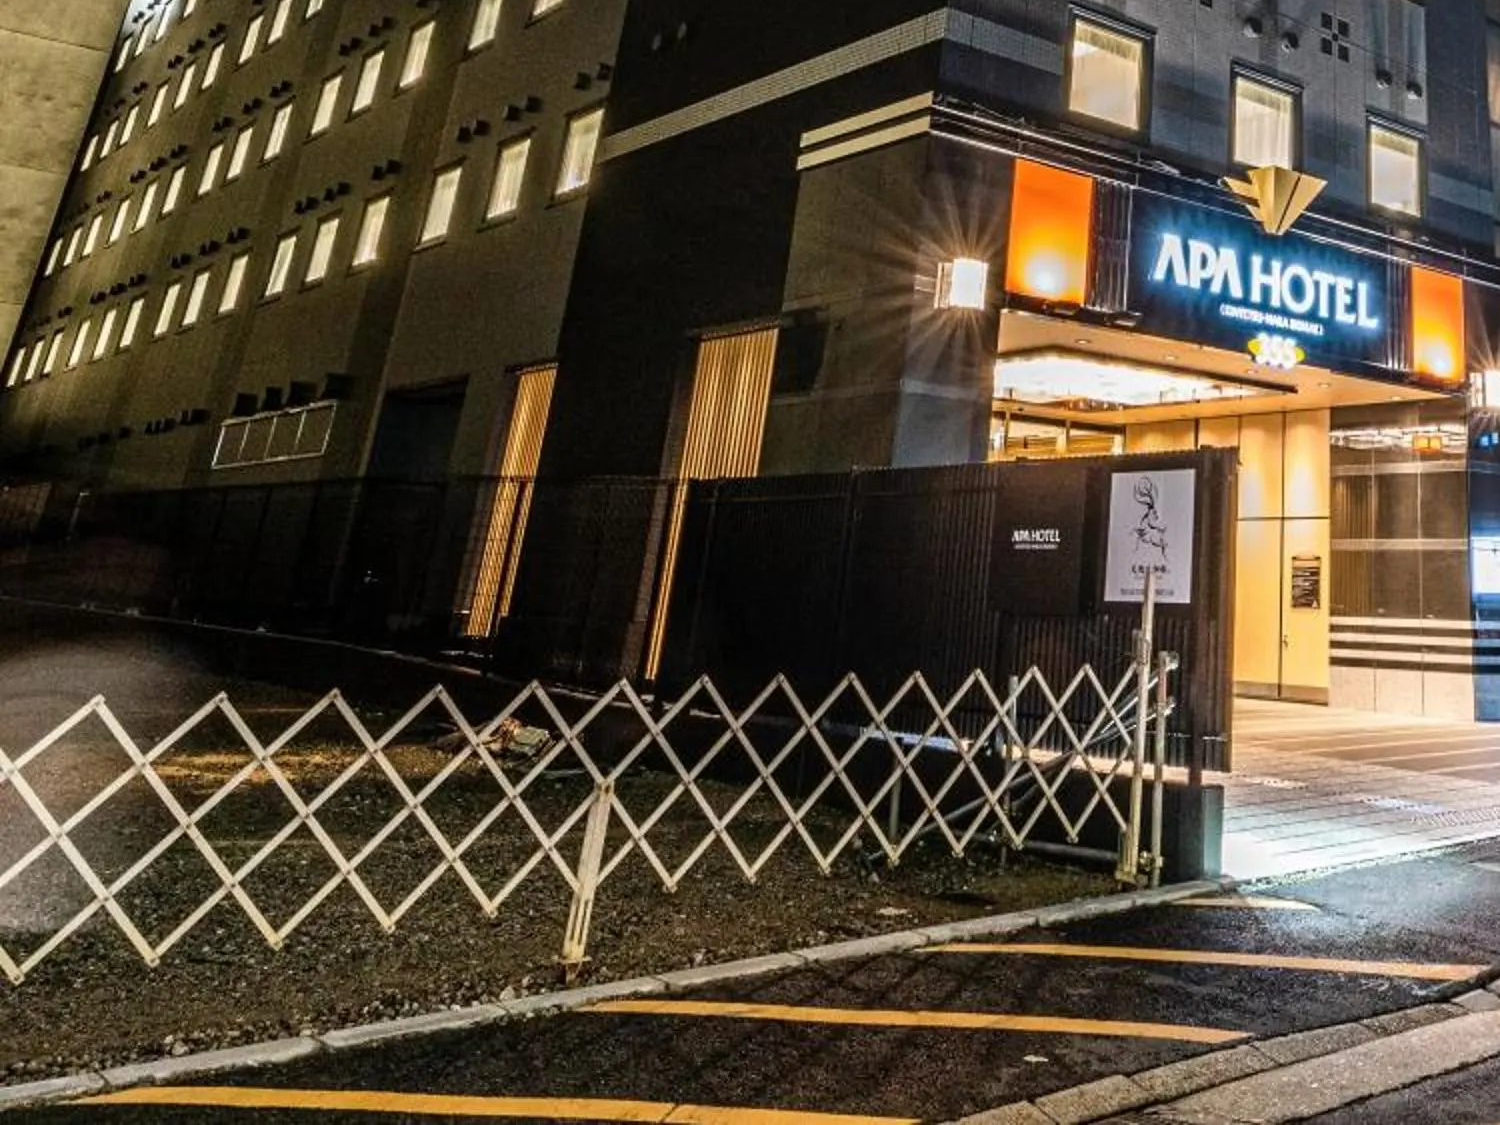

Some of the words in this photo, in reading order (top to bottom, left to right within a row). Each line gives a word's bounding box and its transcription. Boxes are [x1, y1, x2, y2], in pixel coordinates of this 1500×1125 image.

[1153, 232, 1243, 298] APA
[1251, 253, 1379, 328] HOTEL
[1032, 529, 1060, 542] HOTEL
